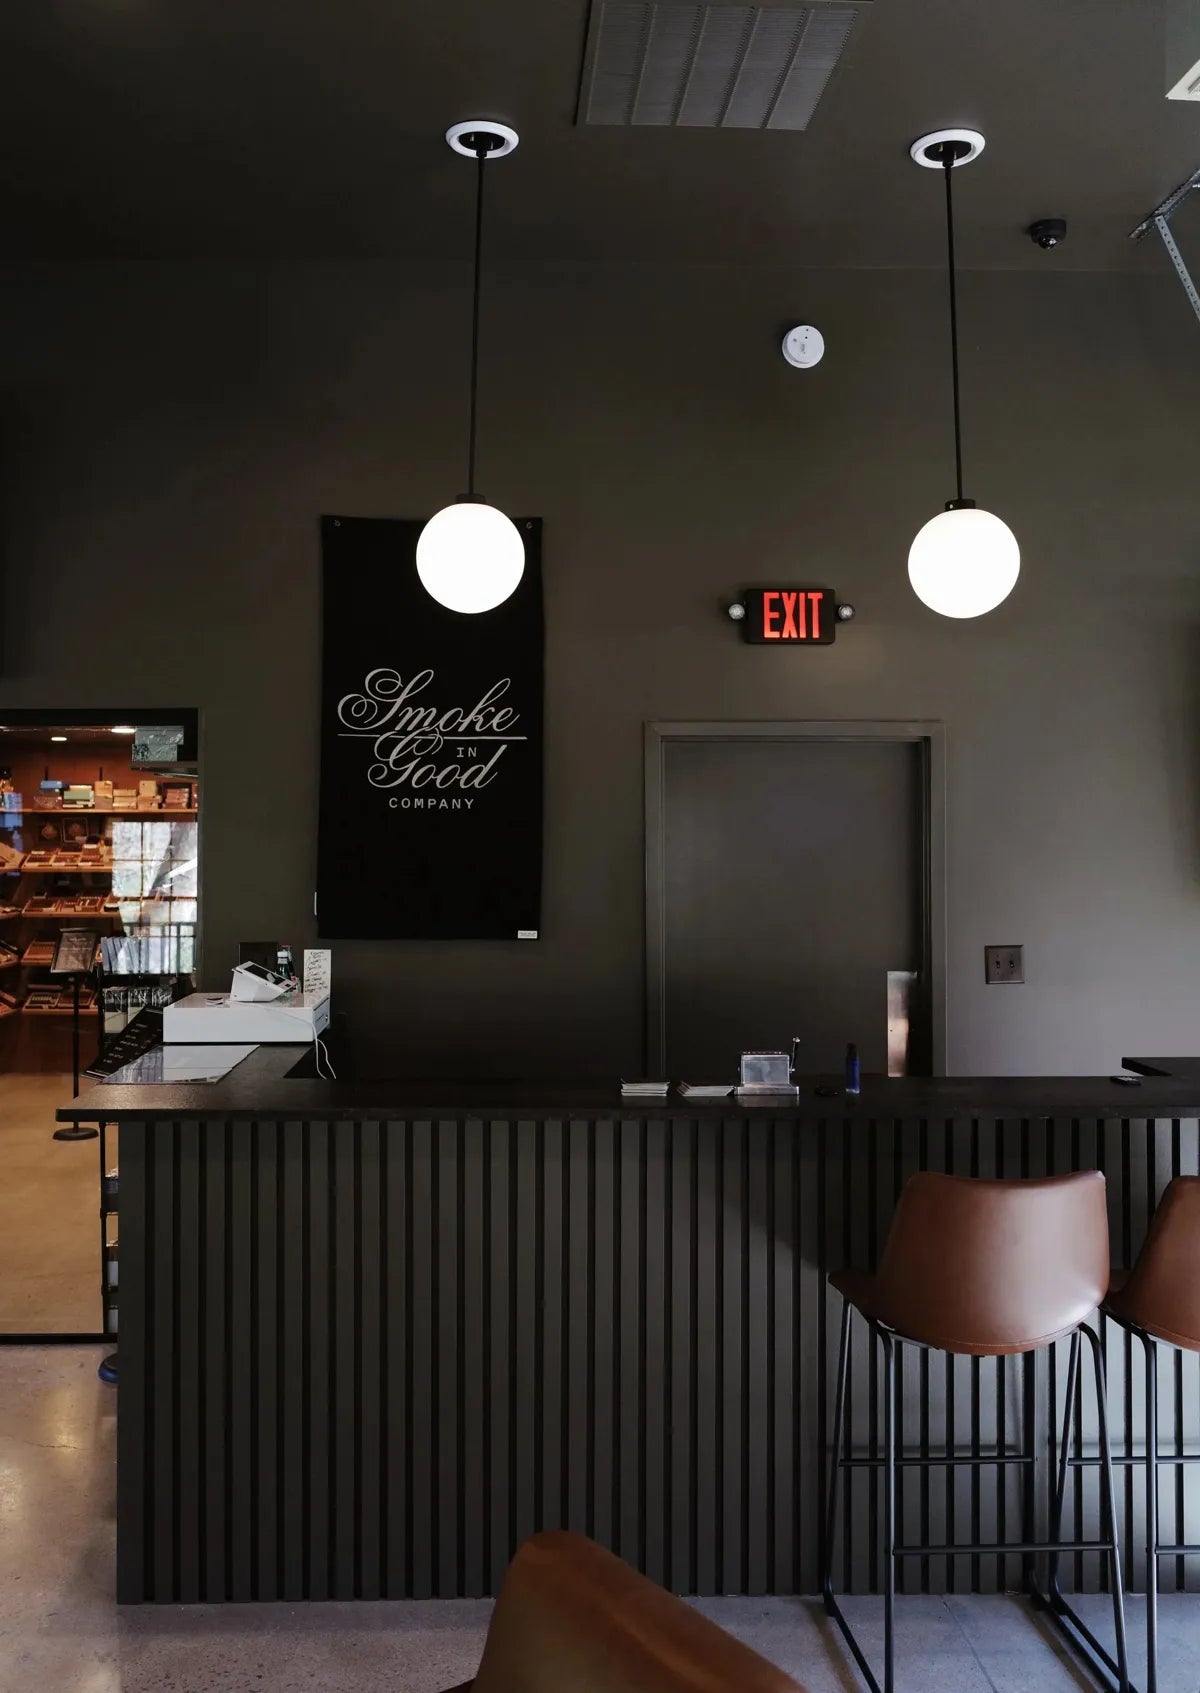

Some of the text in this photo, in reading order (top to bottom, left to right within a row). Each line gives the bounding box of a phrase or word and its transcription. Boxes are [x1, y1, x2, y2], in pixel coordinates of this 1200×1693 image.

[763, 592, 823, 638] EXIT
[338, 668, 520, 732] Smoke
[368, 727, 508, 789] Good
[456, 747, 477, 758] IN
[389, 797, 474, 809] COMPANY
